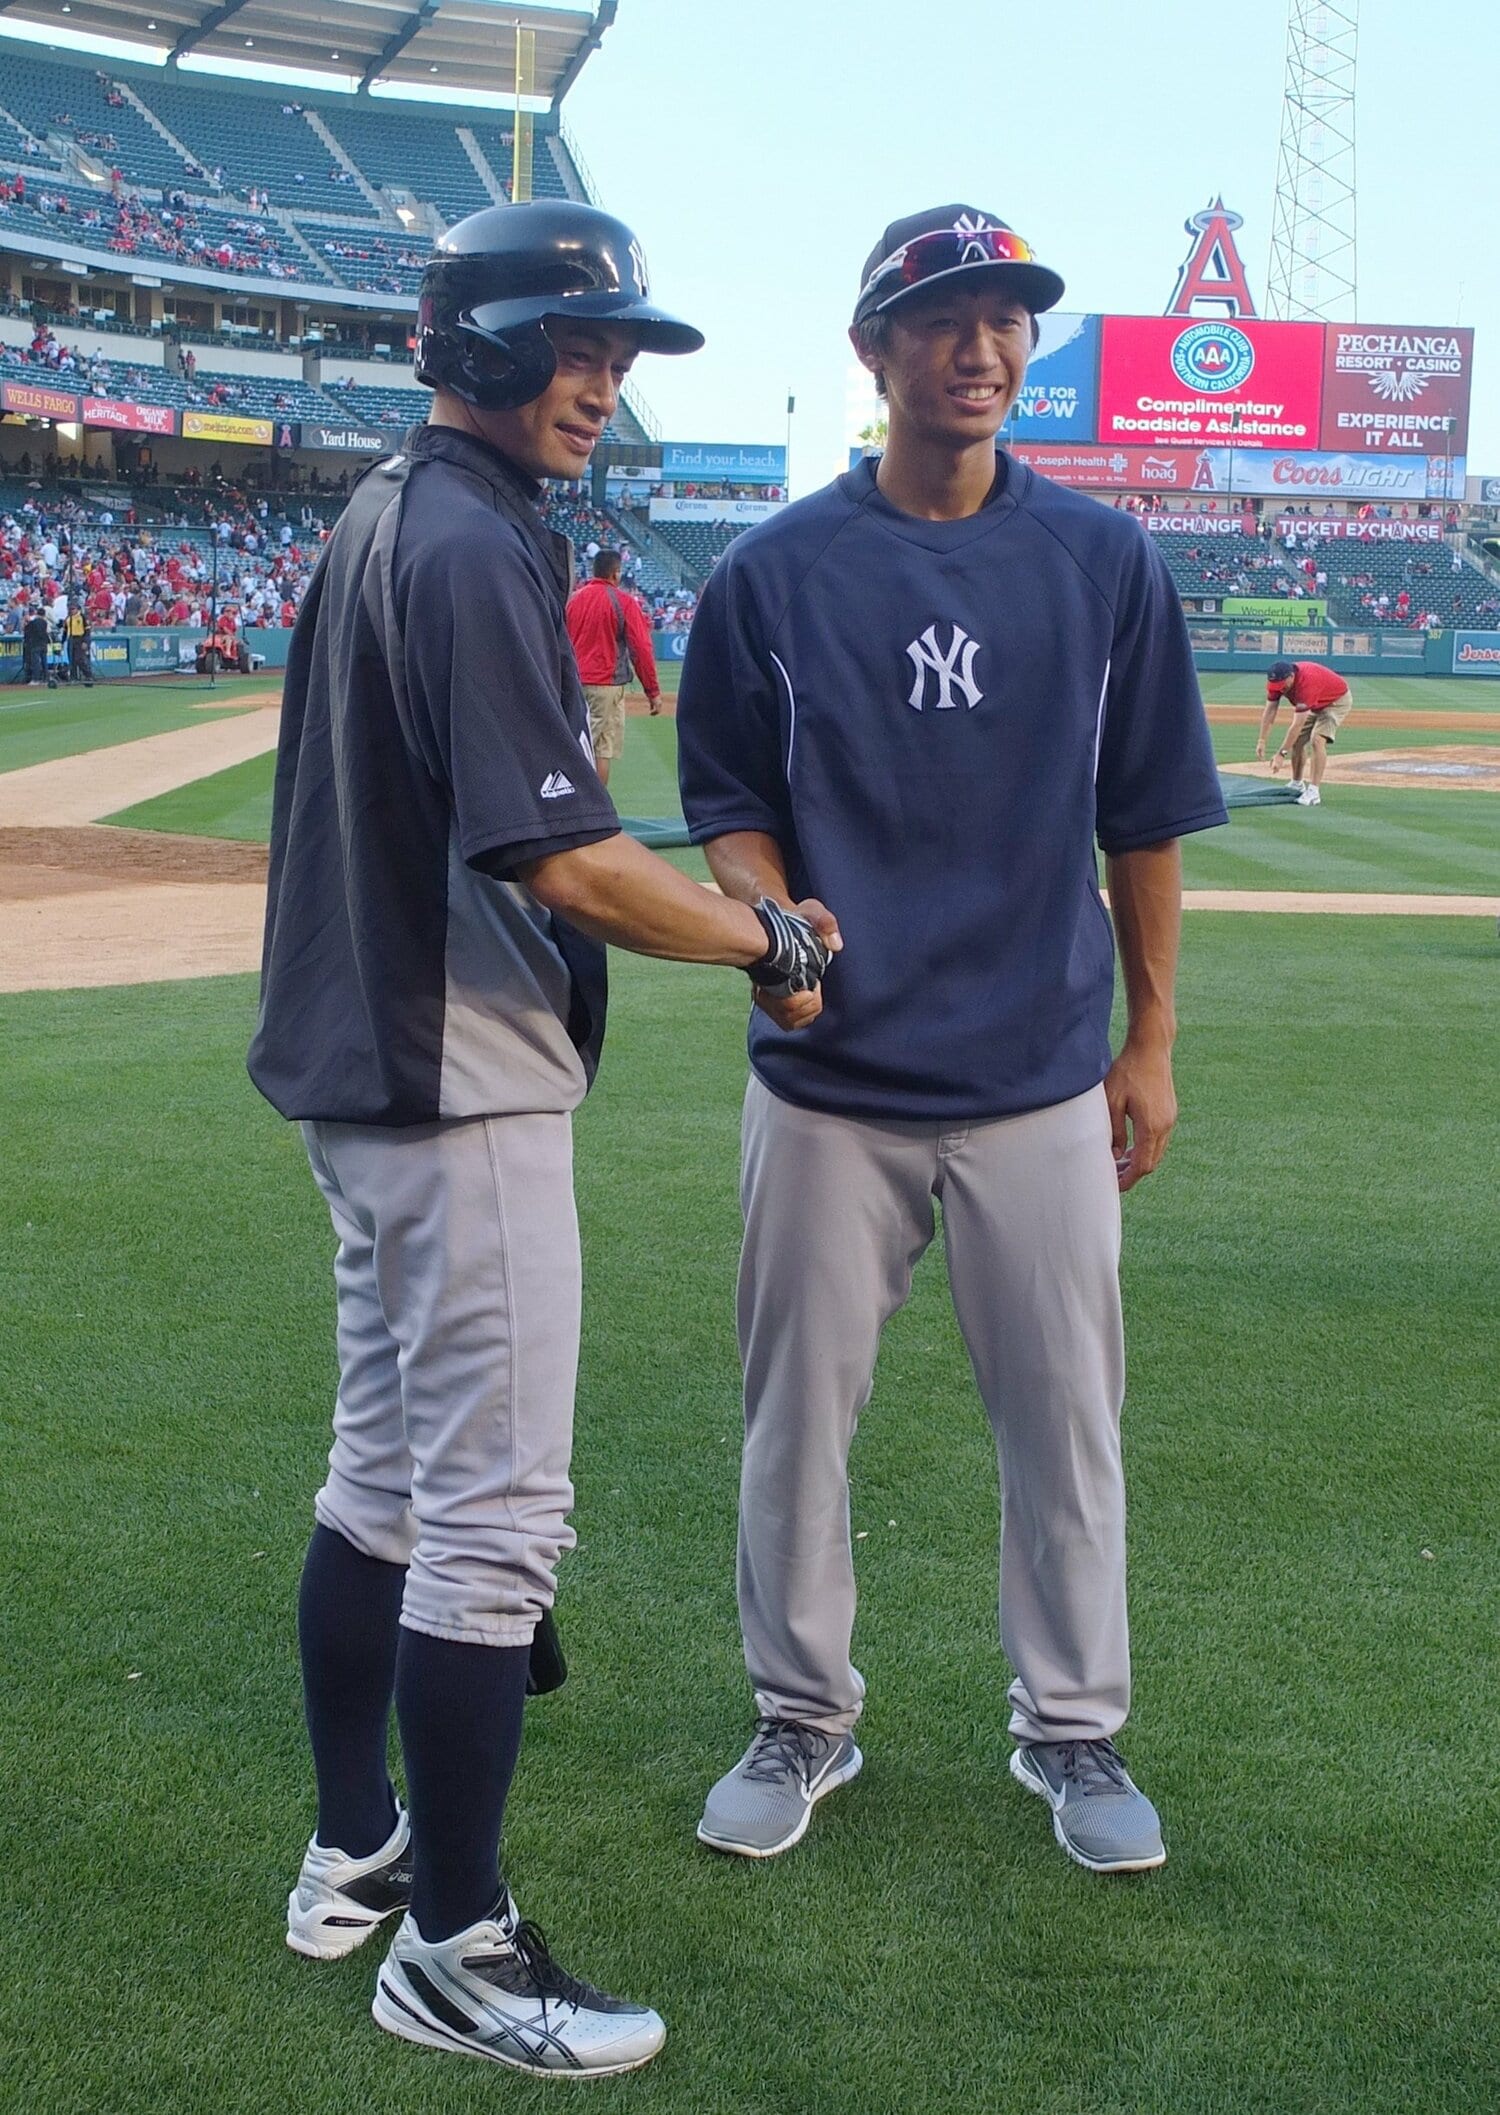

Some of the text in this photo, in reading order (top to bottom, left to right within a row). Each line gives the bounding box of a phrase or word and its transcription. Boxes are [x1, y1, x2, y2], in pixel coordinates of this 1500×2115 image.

[1178, 325, 1249, 352] AUTOMOBILE CLUB
[1336, 334, 1461, 355] PECHANGA
[1194, 346, 1231, 365] AAA
[1336, 356, 1461, 371] RESORT CASINO
[1175, 353, 1250, 390] SOUTHERN CALIFORNIA
[7, 388, 42, 408] WELLS
[44, 397, 75, 414] FARGO
[1018, 386, 1078, 399] LIVE FOR
[84, 408, 129, 424] HERITAGE
[136, 405, 168, 419] ORGANIC
[1018, 400, 1077, 418] NOW
[1137, 397, 1284, 418] Complimentary
[144, 415, 164, 426] MILK
[1112, 416, 1306, 436] Roadside Assistance
[1337, 412, 1449, 431] EXPERIENCE
[320, 430, 382, 448] Yard House
[1365, 431, 1424, 447] IT ALL
[672, 449, 702, 464] Find
[705, 455, 736, 470] your
[1018, 455, 1106, 467] St. Joseph Health
[1142, 465, 1177, 482] hoag
[1272, 456, 1414, 487] Coors LIGHT
[675, 502, 708, 511] Corona
[735, 503, 768, 512] Corona
[1148, 516, 1242, 532] EXCHANGE
[1279, 520, 1438, 538] TICKET EXCHANGE
[1241, 606, 1293, 616] Wonderful
[1458, 644, 1500, 661] Jerse
[906, 624, 984, 711] NY
